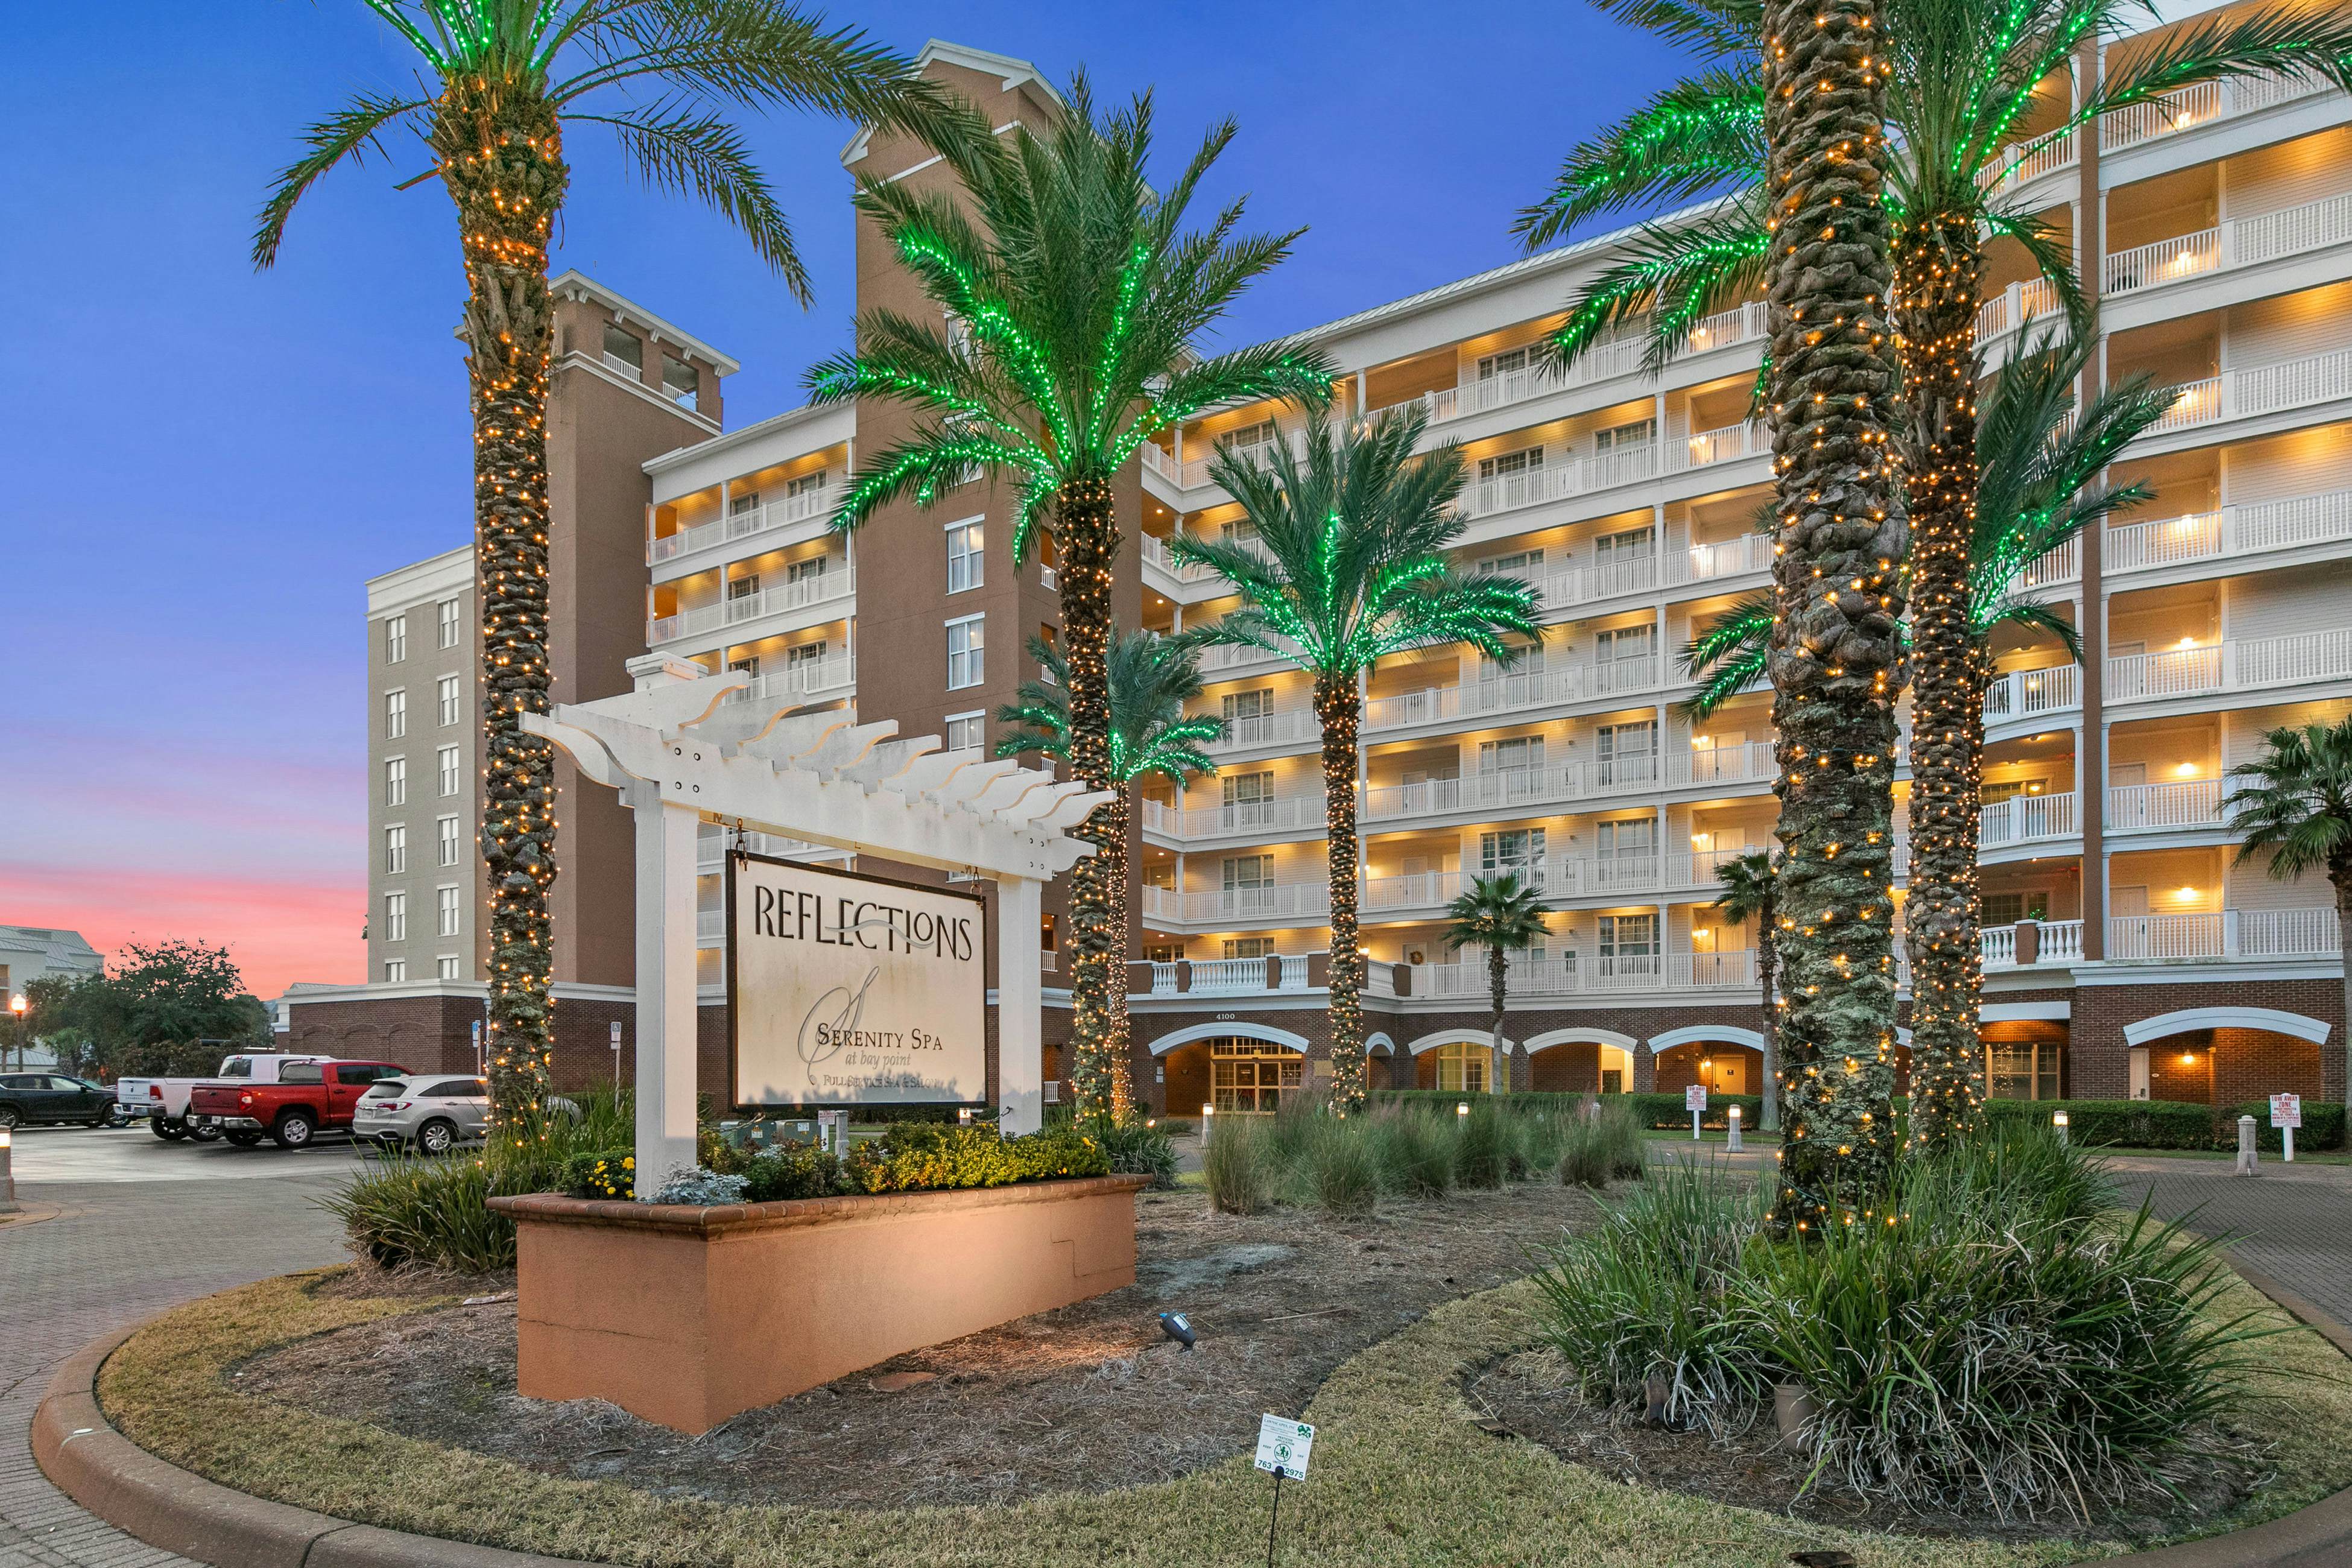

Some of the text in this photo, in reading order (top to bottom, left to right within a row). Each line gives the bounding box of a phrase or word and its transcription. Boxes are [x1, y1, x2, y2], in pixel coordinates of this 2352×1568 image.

[754, 885, 972, 962] REFLECTIONS
[845, 1050, 912, 1071] at bay point
[1258, 1459, 1272, 1469] 763
[1285, 1467, 1304, 1479] 2975
